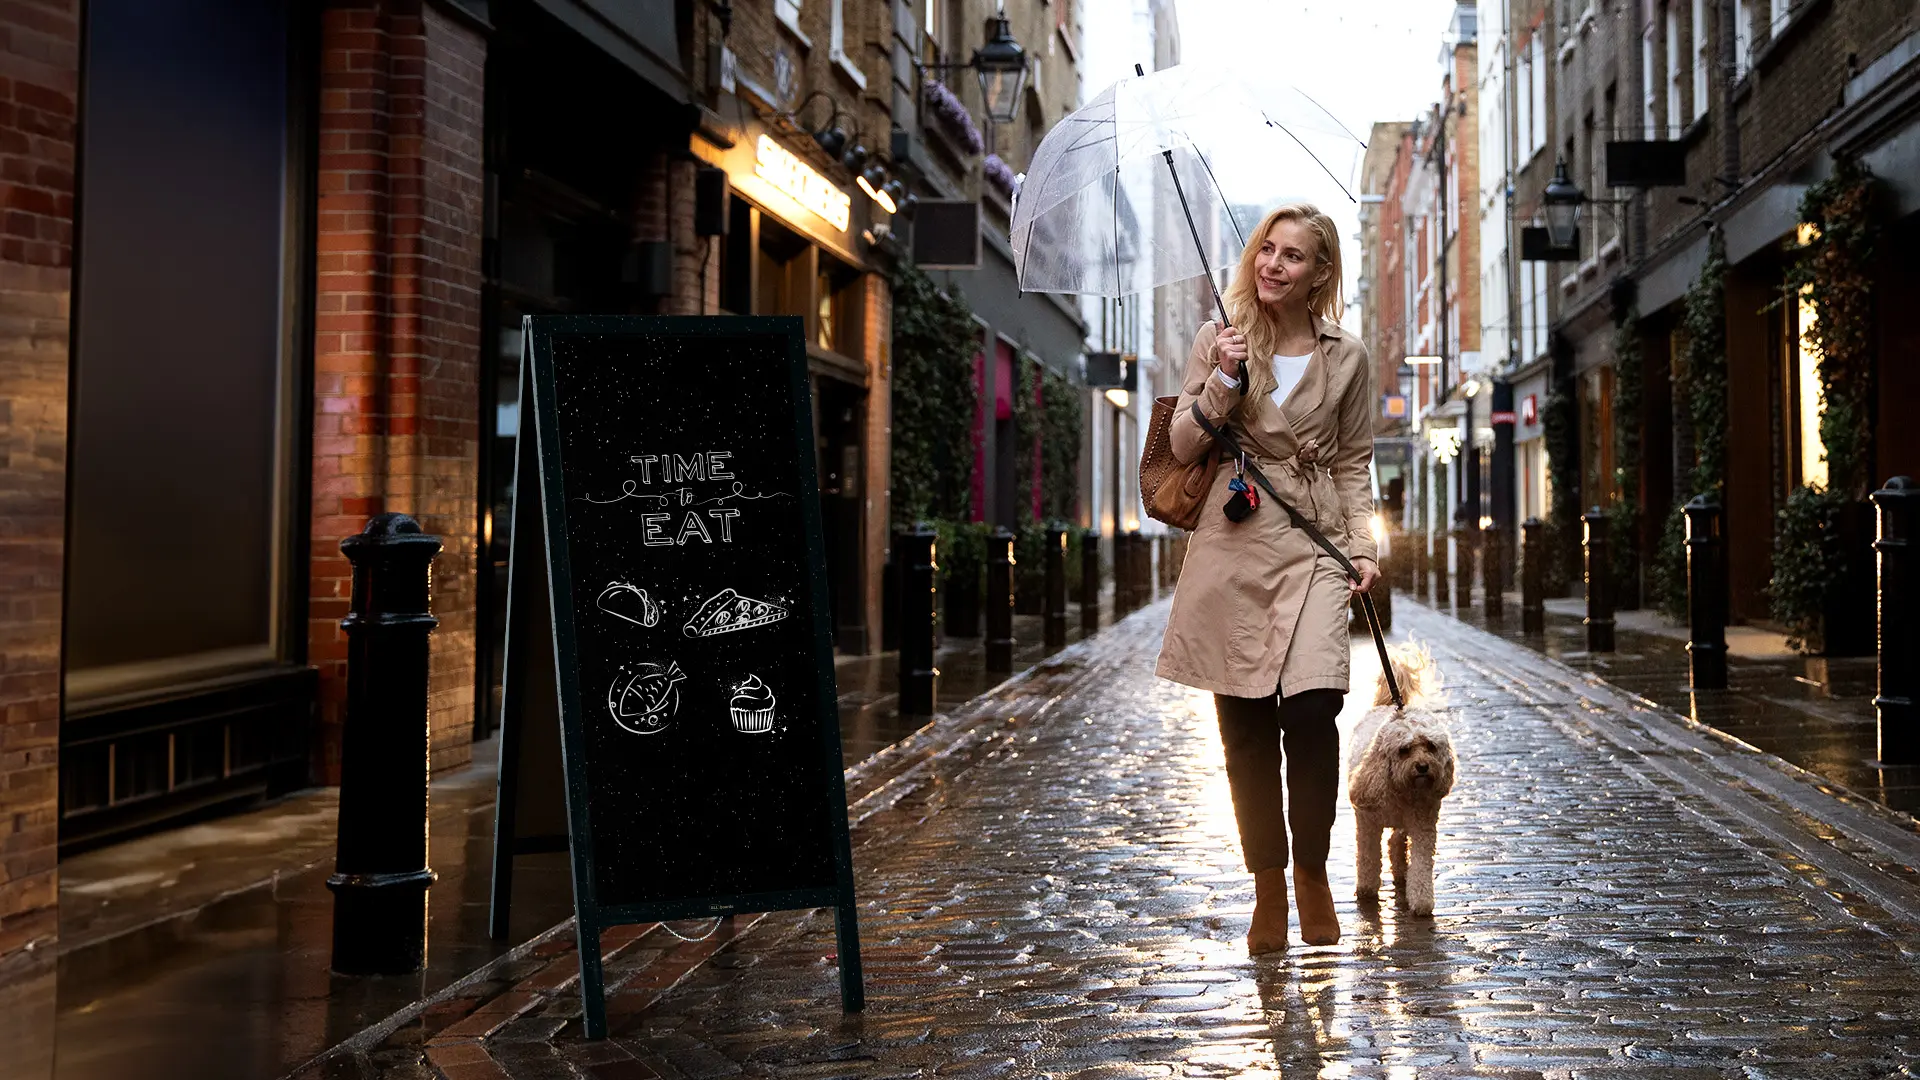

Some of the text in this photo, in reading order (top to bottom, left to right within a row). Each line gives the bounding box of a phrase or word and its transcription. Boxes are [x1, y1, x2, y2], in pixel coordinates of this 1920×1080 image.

[630, 451, 735, 484] TIME
[676, 487, 693, 506] to
[641, 508, 741, 547] EAT
